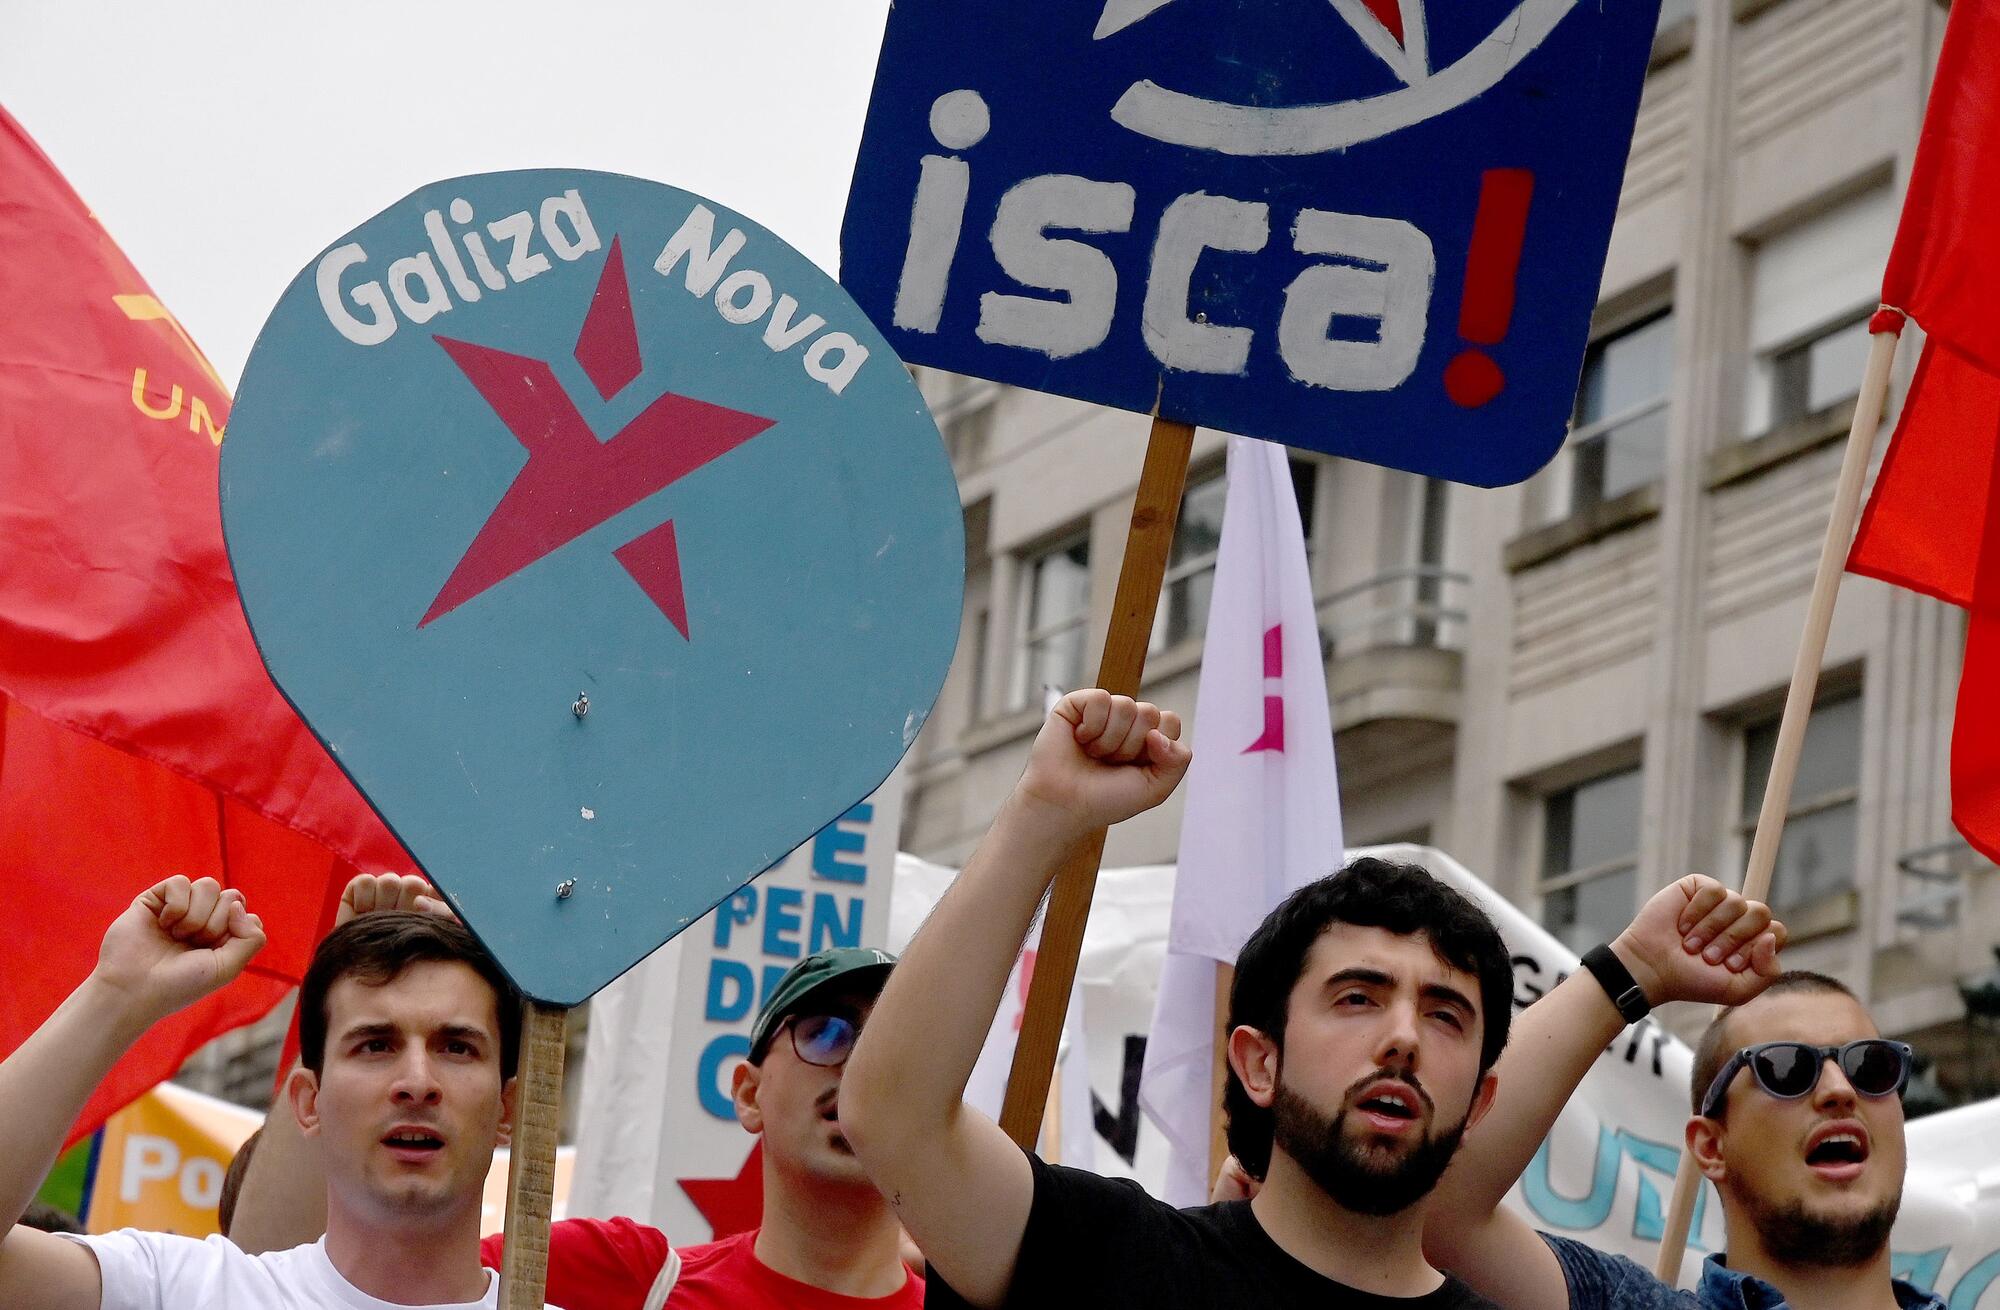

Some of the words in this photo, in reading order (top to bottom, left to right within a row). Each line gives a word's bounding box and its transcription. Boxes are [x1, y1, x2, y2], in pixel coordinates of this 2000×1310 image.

[315, 189, 601, 345] Galiza
[653, 204, 869, 395] Nova
[893, 89, 1535, 409] isca!
[713, 882, 864, 957] PEN
